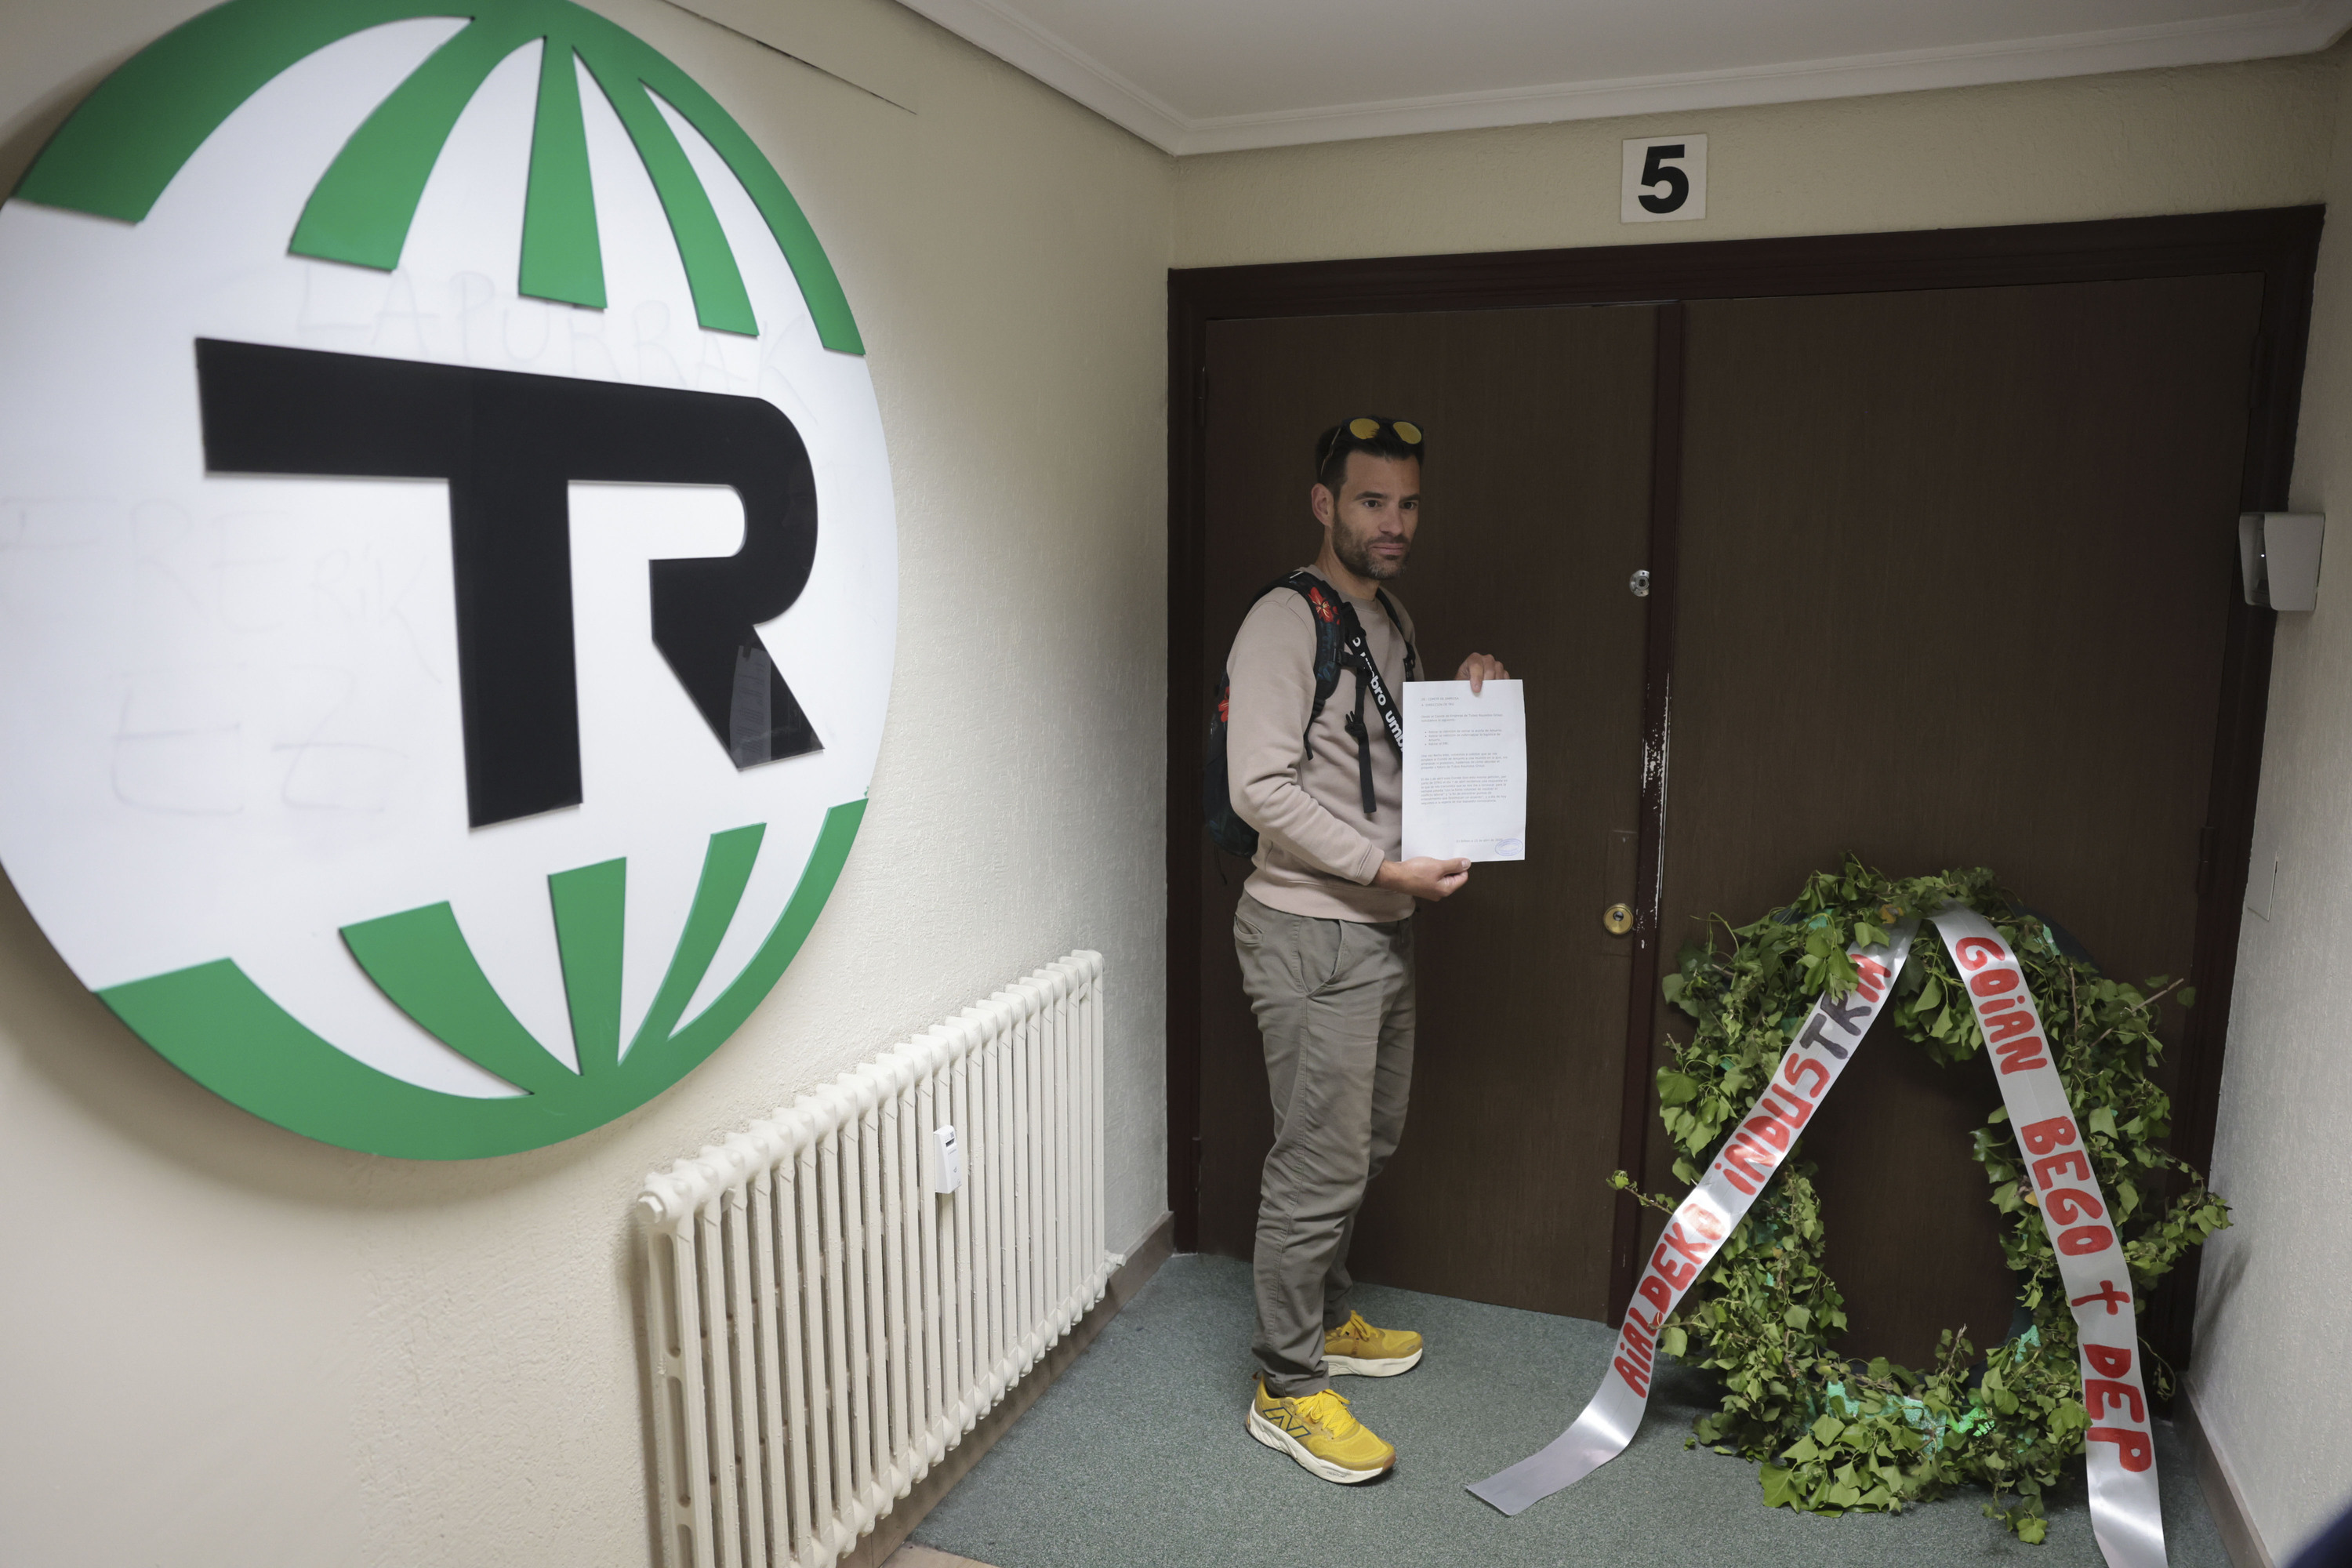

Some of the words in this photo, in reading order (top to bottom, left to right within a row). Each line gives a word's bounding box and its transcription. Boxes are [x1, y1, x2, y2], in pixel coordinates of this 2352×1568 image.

[1638, 144, 1689, 214] 5
[196, 338, 822, 827] TR
[1385, 710, 1403, 753] umb
[2020, 1116, 2114, 1256] BEGO
[2083, 1344, 2152, 1472] DEP
